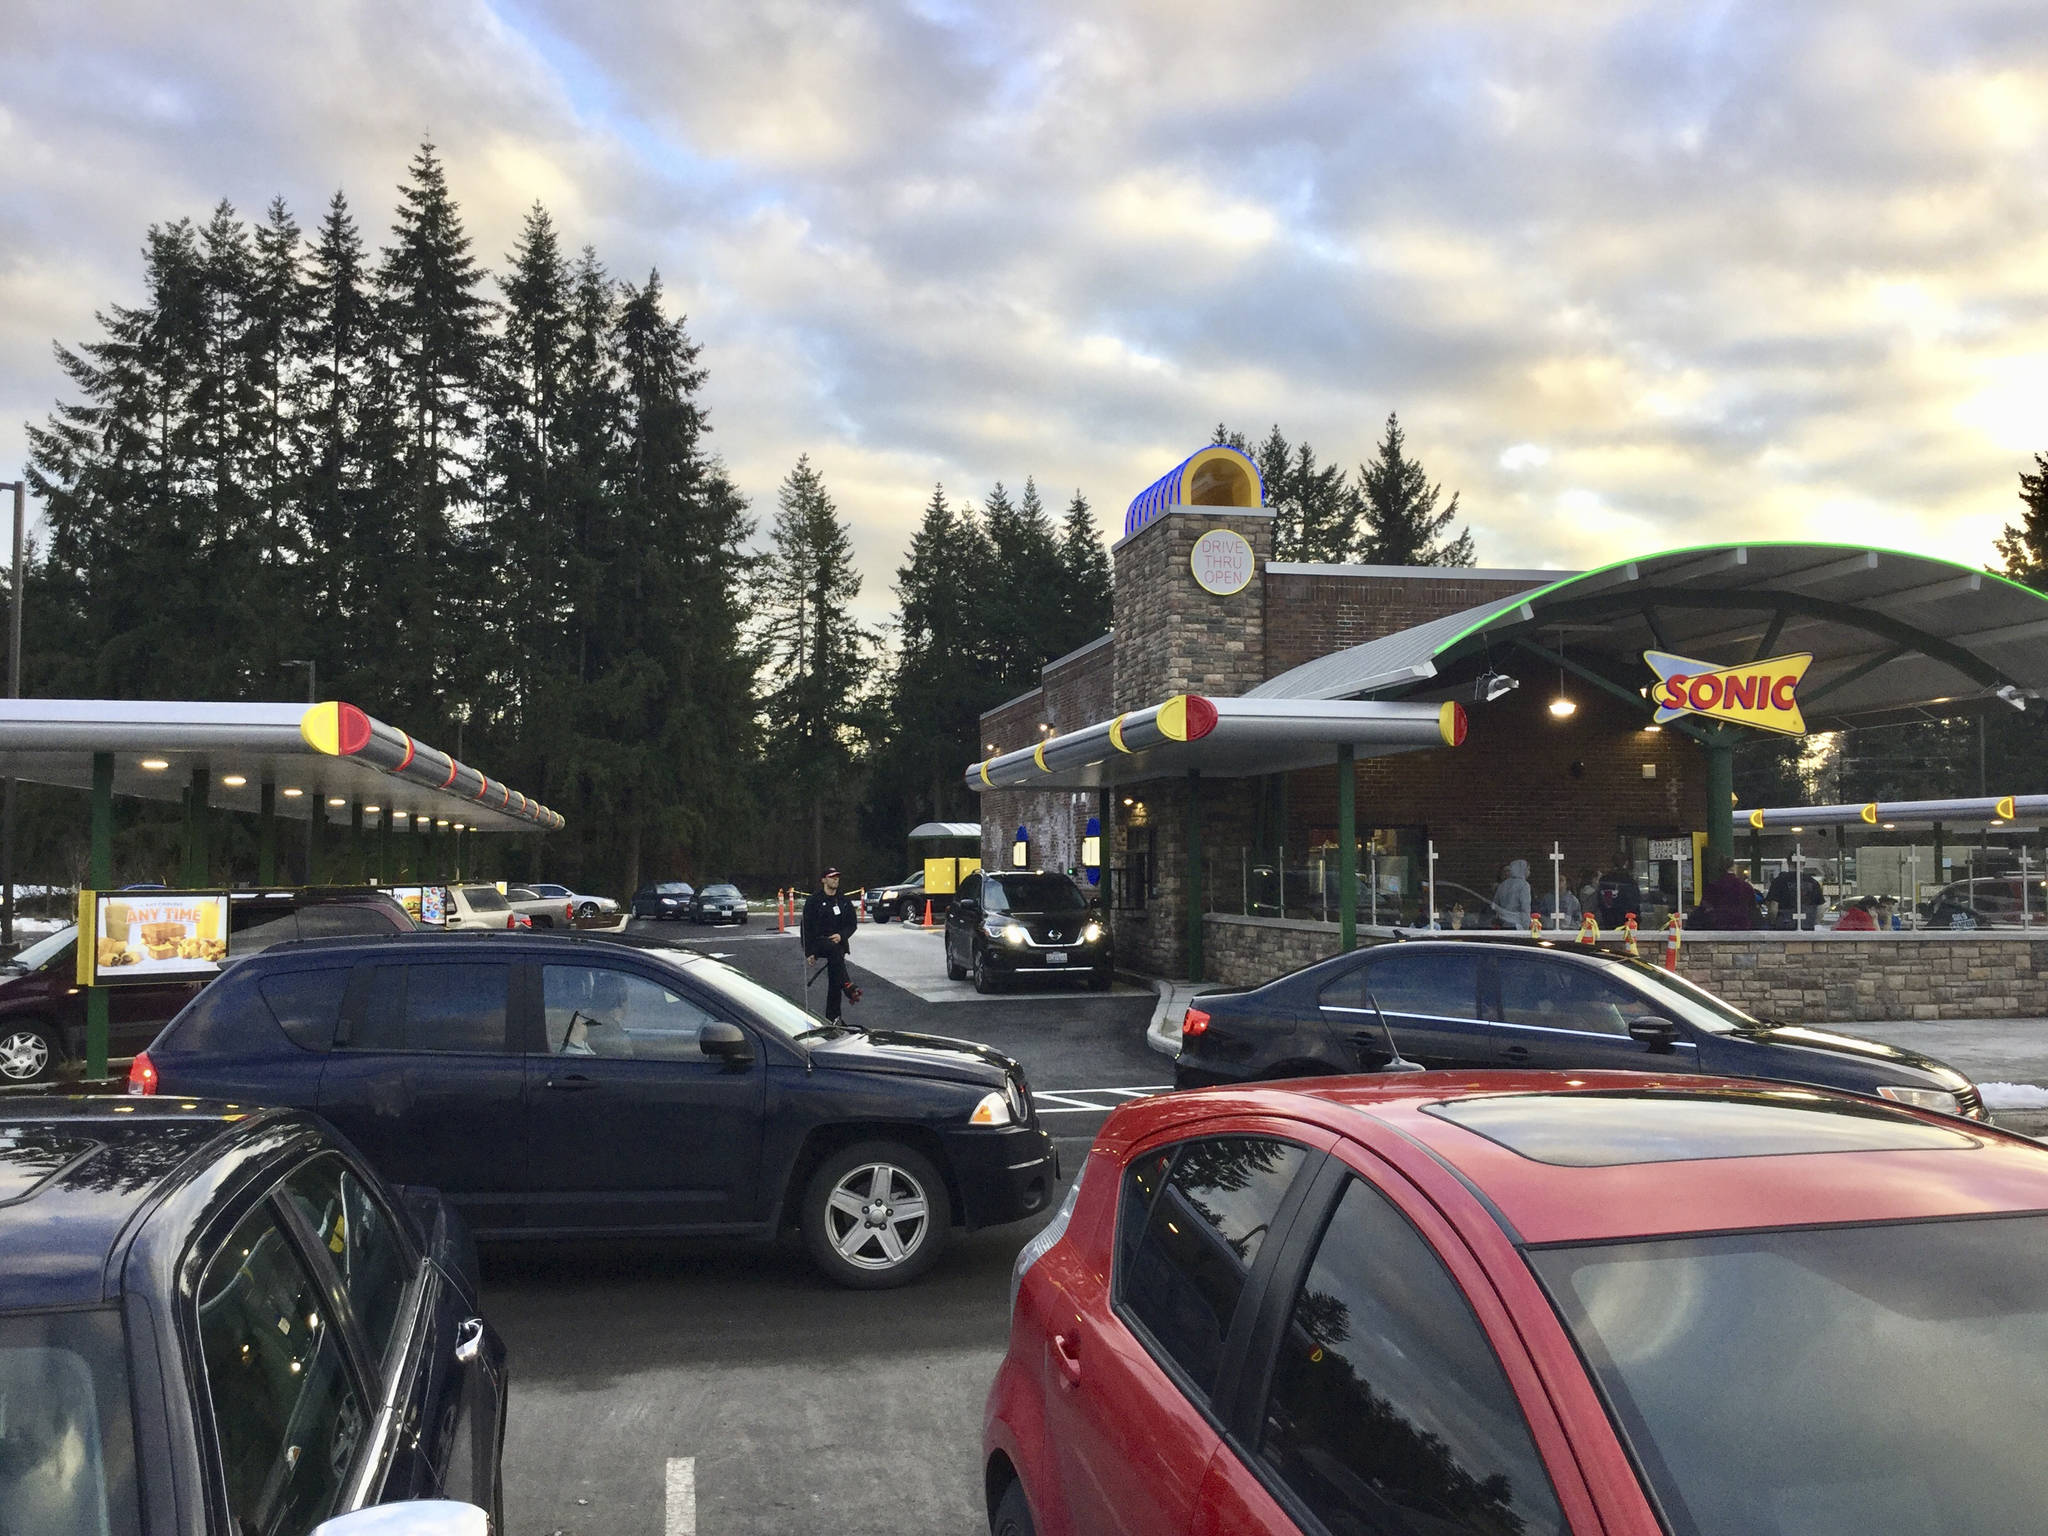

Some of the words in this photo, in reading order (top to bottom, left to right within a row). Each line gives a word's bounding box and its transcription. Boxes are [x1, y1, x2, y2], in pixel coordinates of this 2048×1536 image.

[1202, 539, 1244, 554] DRIVE
[1205, 555, 1242, 570] THRU
[1204, 570, 1242, 585] OPEN
[1661, 673, 1799, 711] SONIC
[126, 908, 158, 923] ANY
[165, 907, 201, 923] TIME
